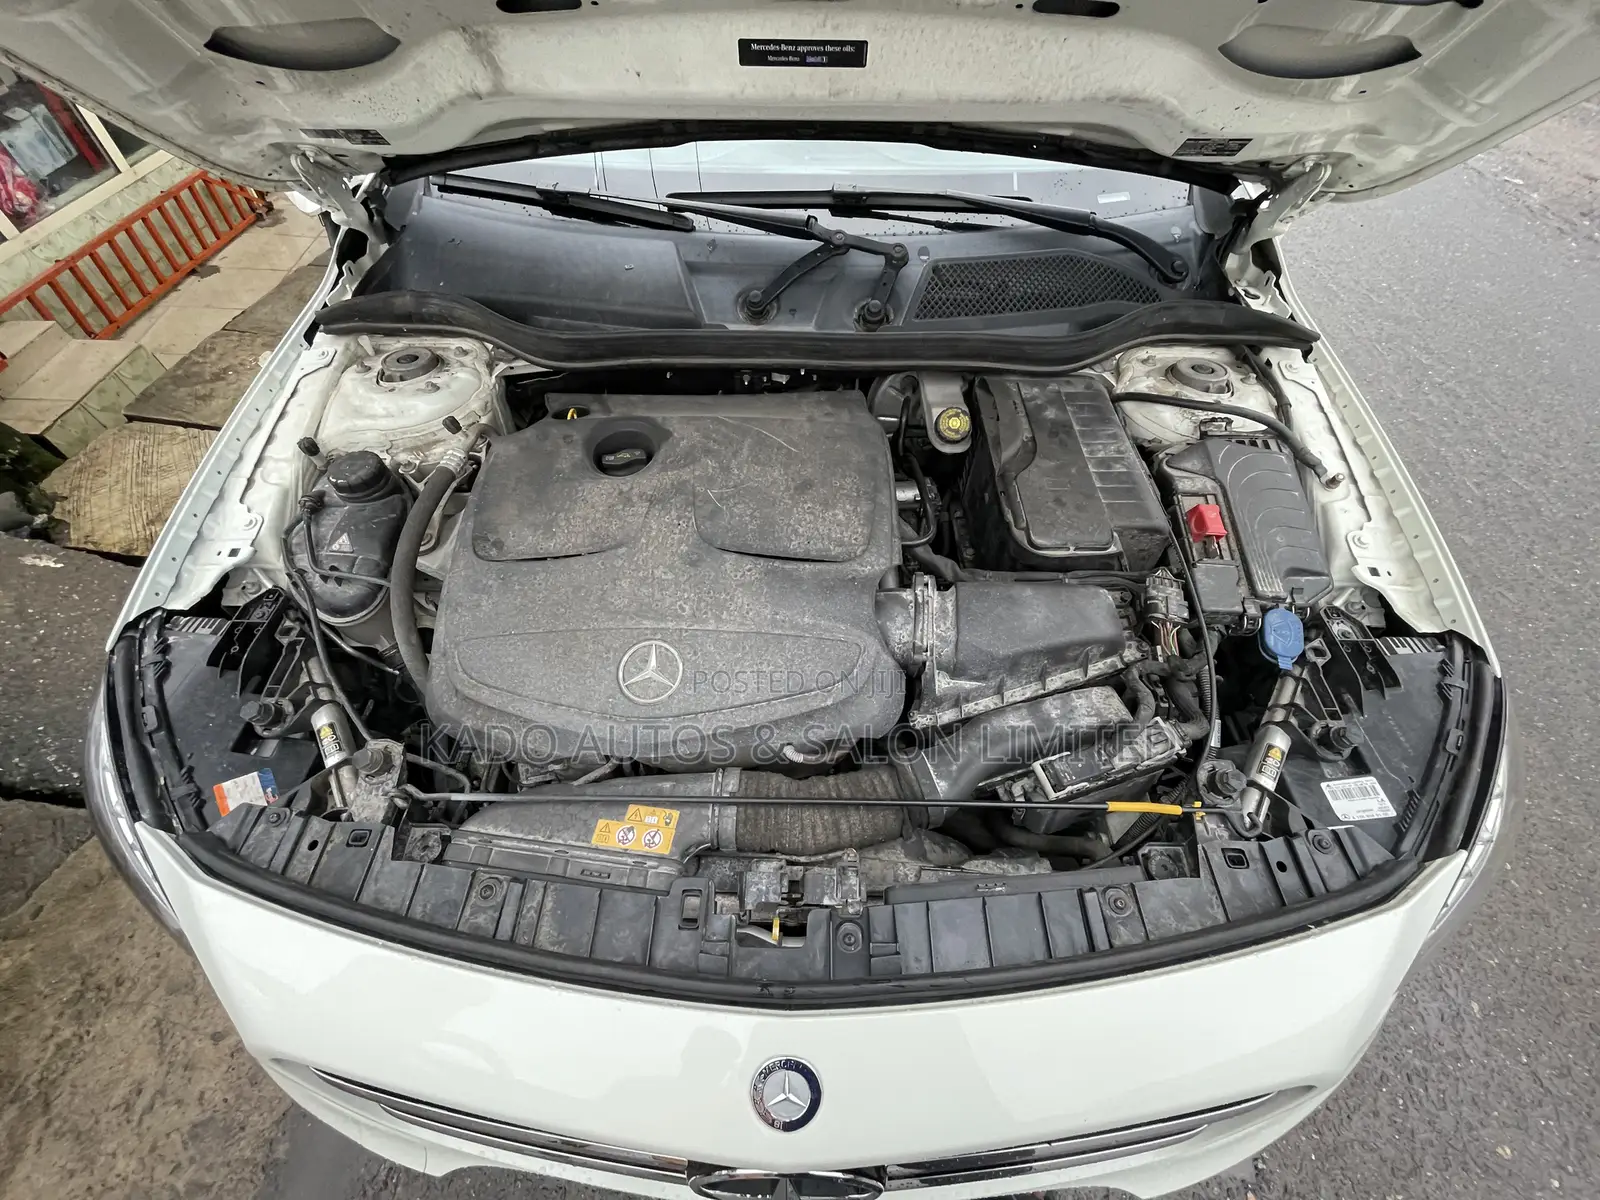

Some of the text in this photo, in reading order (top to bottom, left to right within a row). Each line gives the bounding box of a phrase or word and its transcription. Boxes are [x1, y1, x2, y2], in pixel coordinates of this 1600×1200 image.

[750, 43, 796, 51] Mercedes-Benz
[796, 44, 824, 53] approves
[825, 44, 841, 52] these
